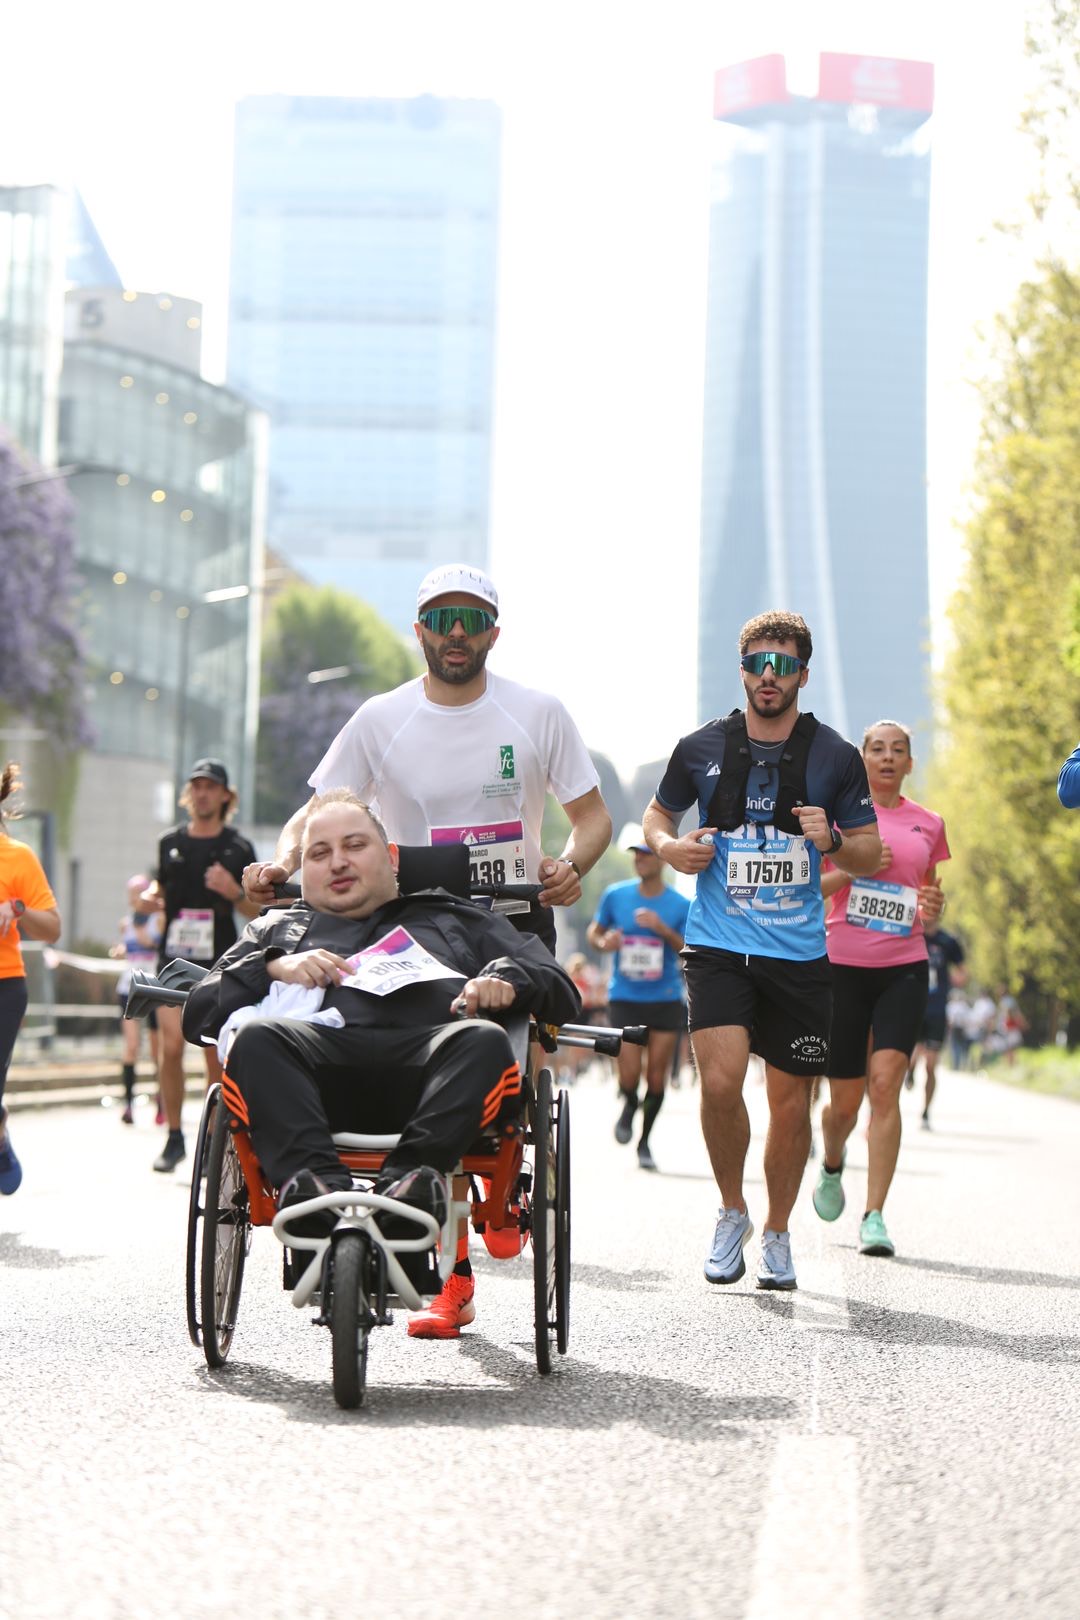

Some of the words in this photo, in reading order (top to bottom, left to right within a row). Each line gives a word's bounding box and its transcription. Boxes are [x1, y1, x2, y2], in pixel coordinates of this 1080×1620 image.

[469, 849, 488, 858] MARCO
[745, 861, 793, 884] 1757B
[790, 1035, 822, 1050] REEBOK
